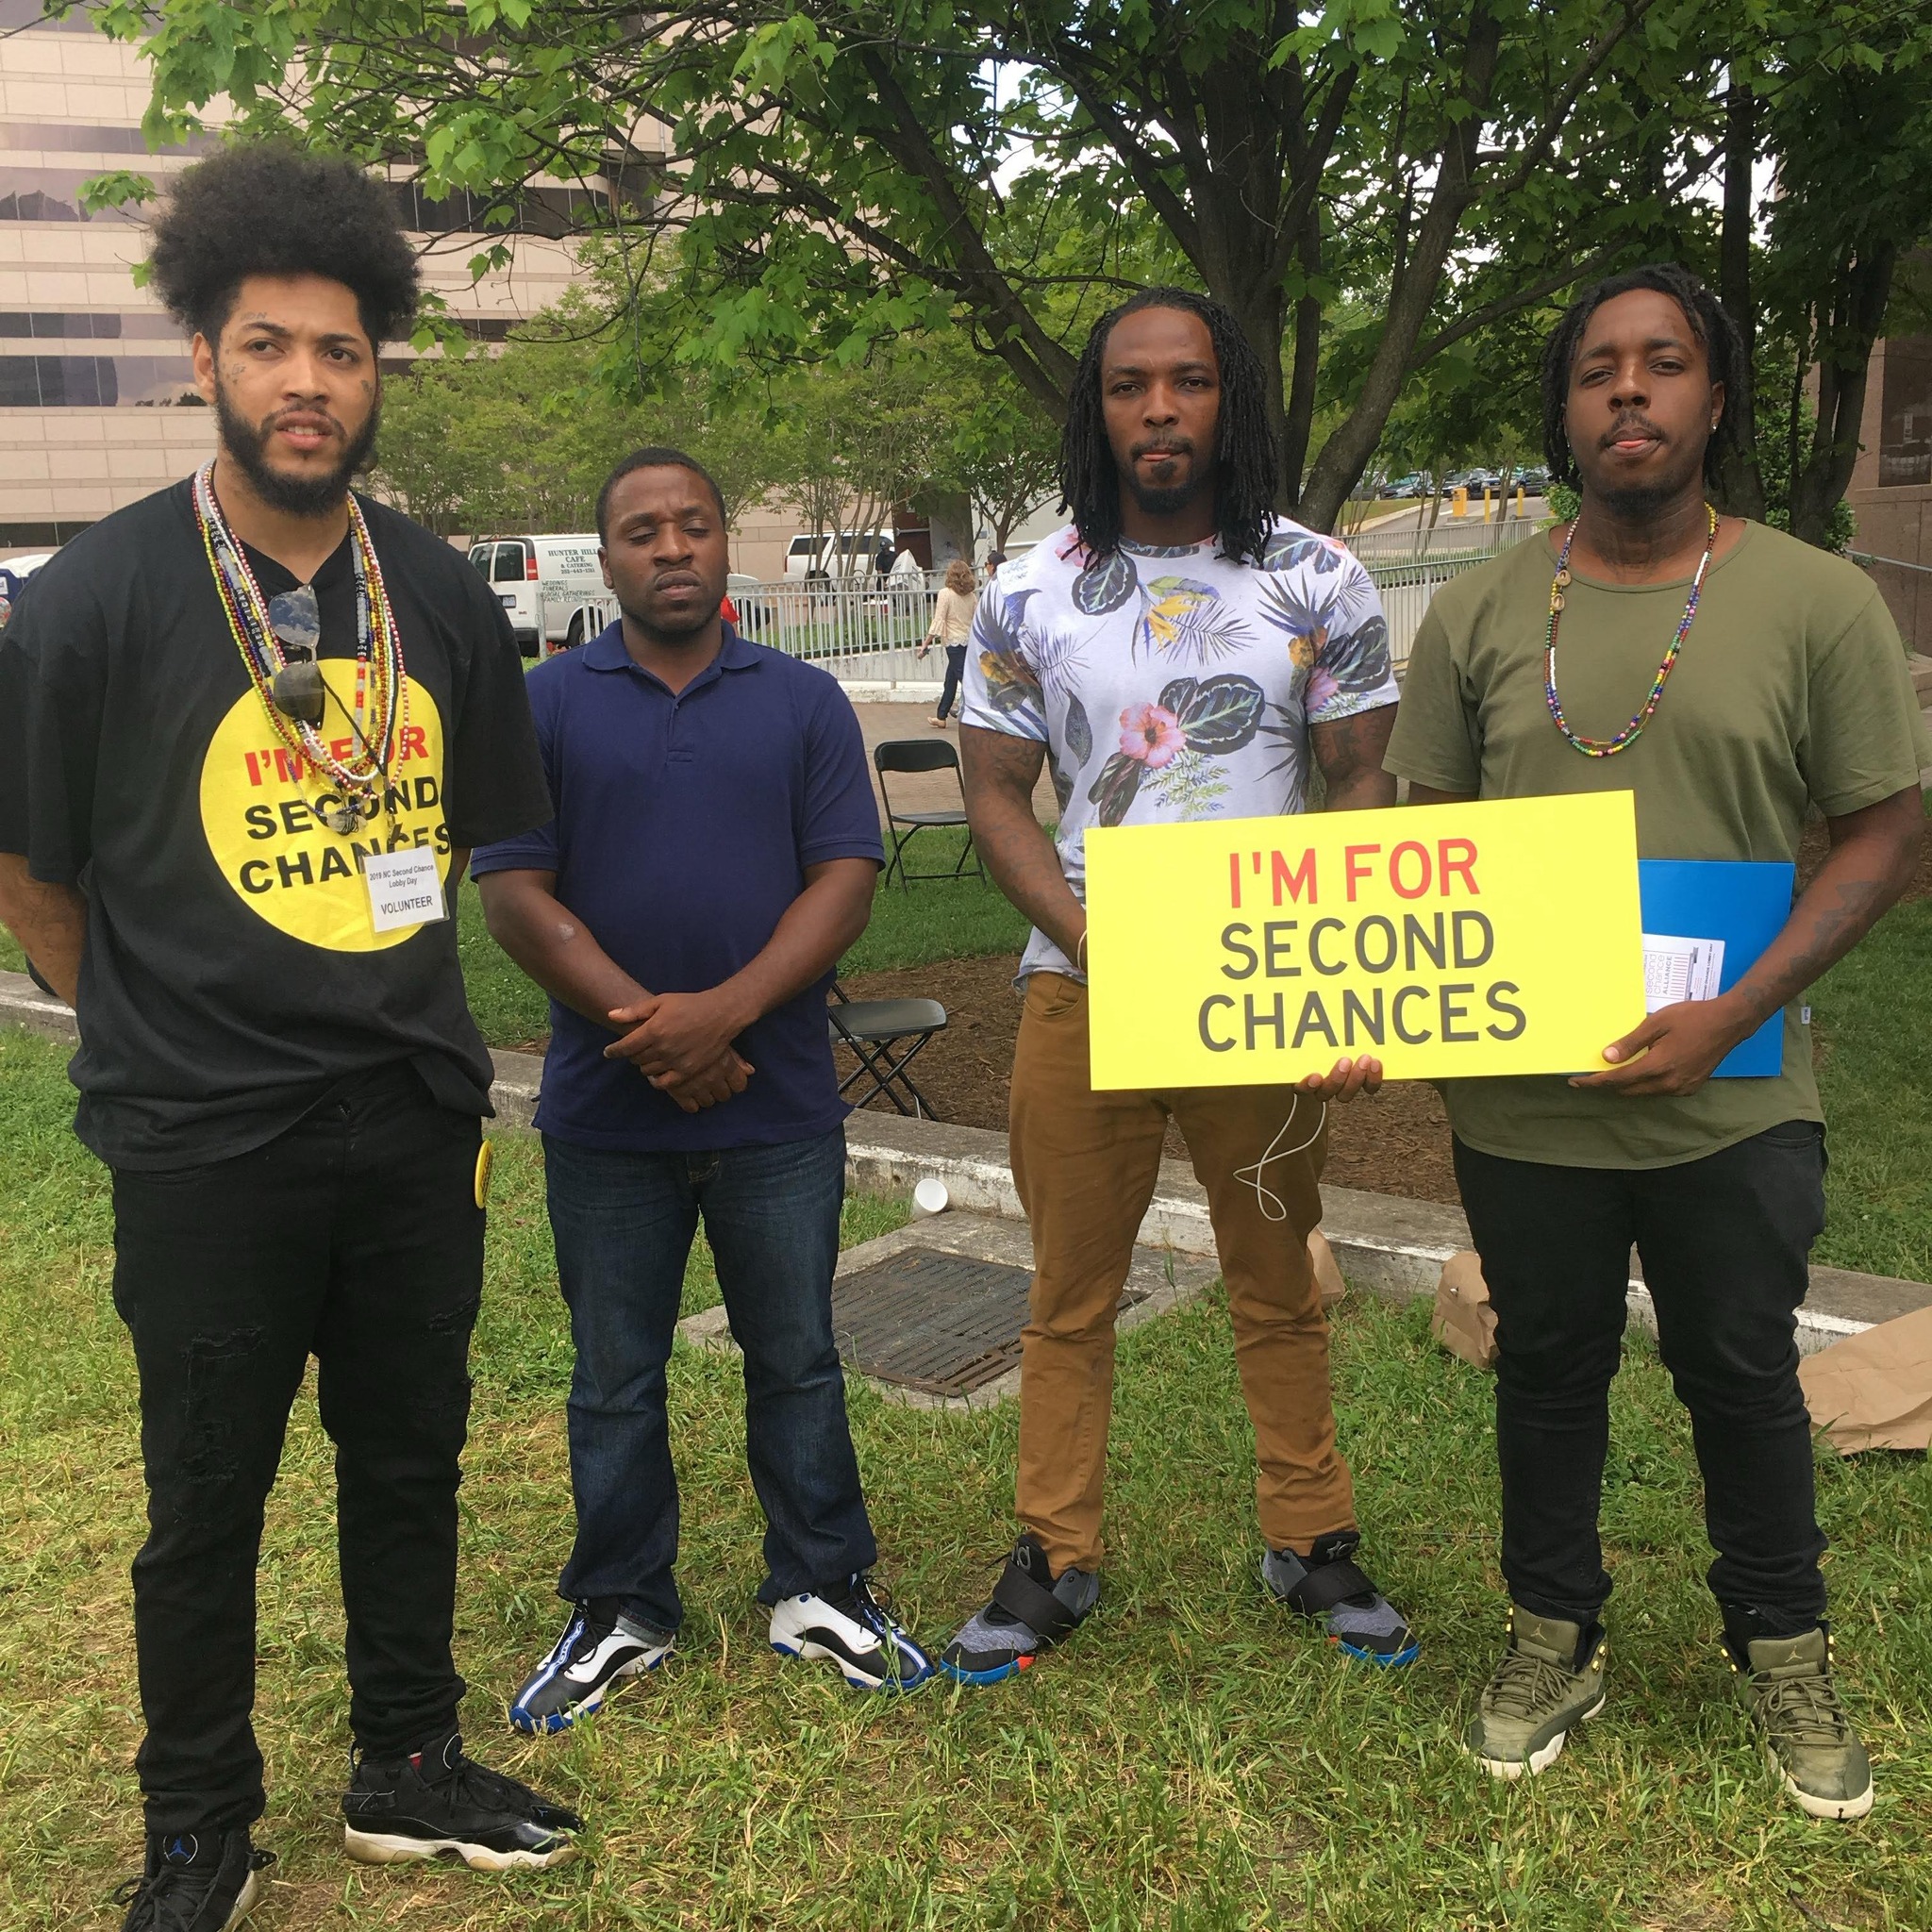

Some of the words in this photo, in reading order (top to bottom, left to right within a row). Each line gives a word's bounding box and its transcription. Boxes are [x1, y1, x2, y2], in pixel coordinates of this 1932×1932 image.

[244, 748, 317, 786] I'M
[383, 870, 391, 878] NC
[392, 866, 413, 877] Second
[414, 864, 433, 874] Chance
[389, 879, 406, 888] Lobby
[407, 877, 417, 885] Day
[1229, 848, 1317, 908] I'M
[1344, 838, 1480, 902] FOR
[381, 895, 433, 915] VOLUNTEER
[1219, 909, 1494, 980] SECOND
[1646, 954, 1657, 994] second
[1654, 955, 1665, 994] chance
[1663, 956, 1672, 995] ALLIANCE
[1197, 980, 1526, 1052] CHANCES
